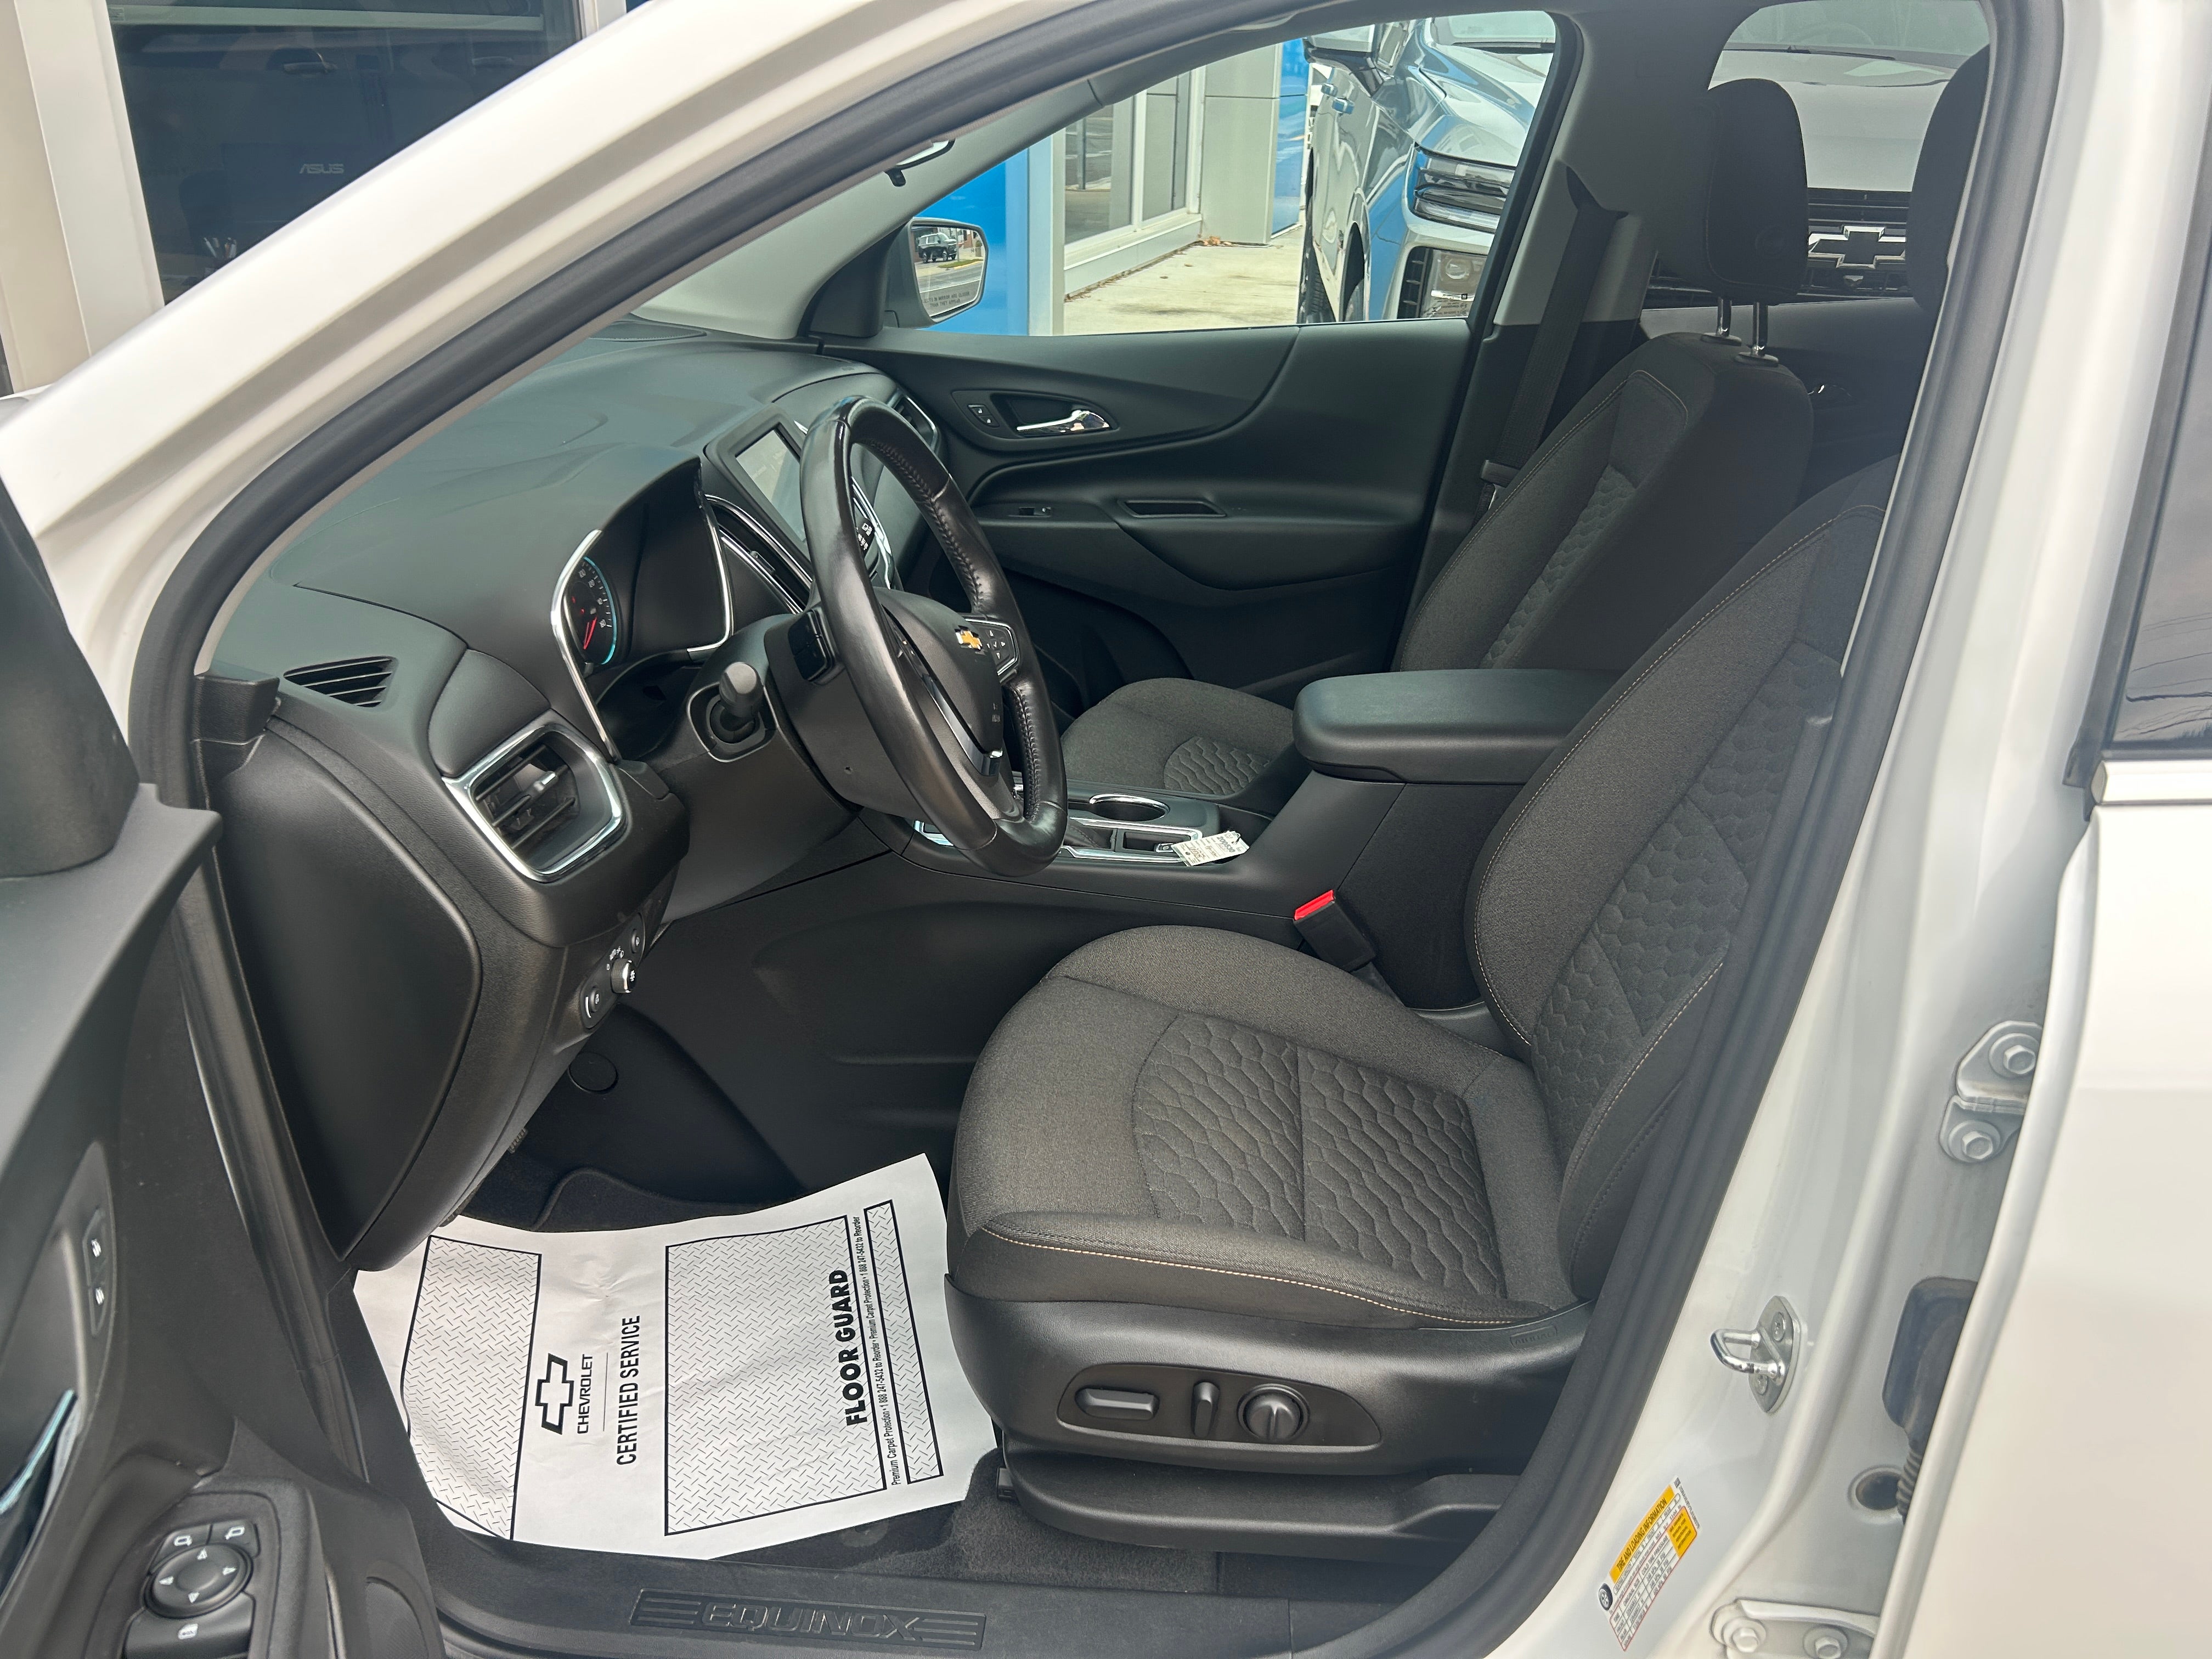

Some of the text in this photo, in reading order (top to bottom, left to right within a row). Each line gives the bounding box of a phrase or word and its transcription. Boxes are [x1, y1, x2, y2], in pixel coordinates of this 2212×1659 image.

[300, 163, 344, 174] ASUS
[853, 1217, 863, 1237] Reorder
[855, 1242, 866, 1263] 247-5432
[859, 1263, 867, 1272] 888
[861, 1278, 872, 1304] Protection
[866, 1303, 876, 1319] Carpet
[868, 1319, 878, 1339] Premium
[829, 1269, 868, 1426] FLOOR GUARD
[869, 1341, 883, 1362] Reorder
[616, 1316, 640, 1465] CERTIFIED SERVICE
[874, 1368, 886, 1393] 247-5432
[577, 1354, 593, 1434] CHEVROLET
[878, 1393, 888, 1403] 888
[881, 1410, 893, 1437] Protection
[885, 1439, 898, 1458] Carpet
[891, 1459, 901, 1485] Premium
[1616, 1496, 1667, 1572] TIRE AND LOADING INFORMATION
[1654, 1534, 1668, 1557] PRESSURE
[701, 1601, 923, 1641] EQUINOX
